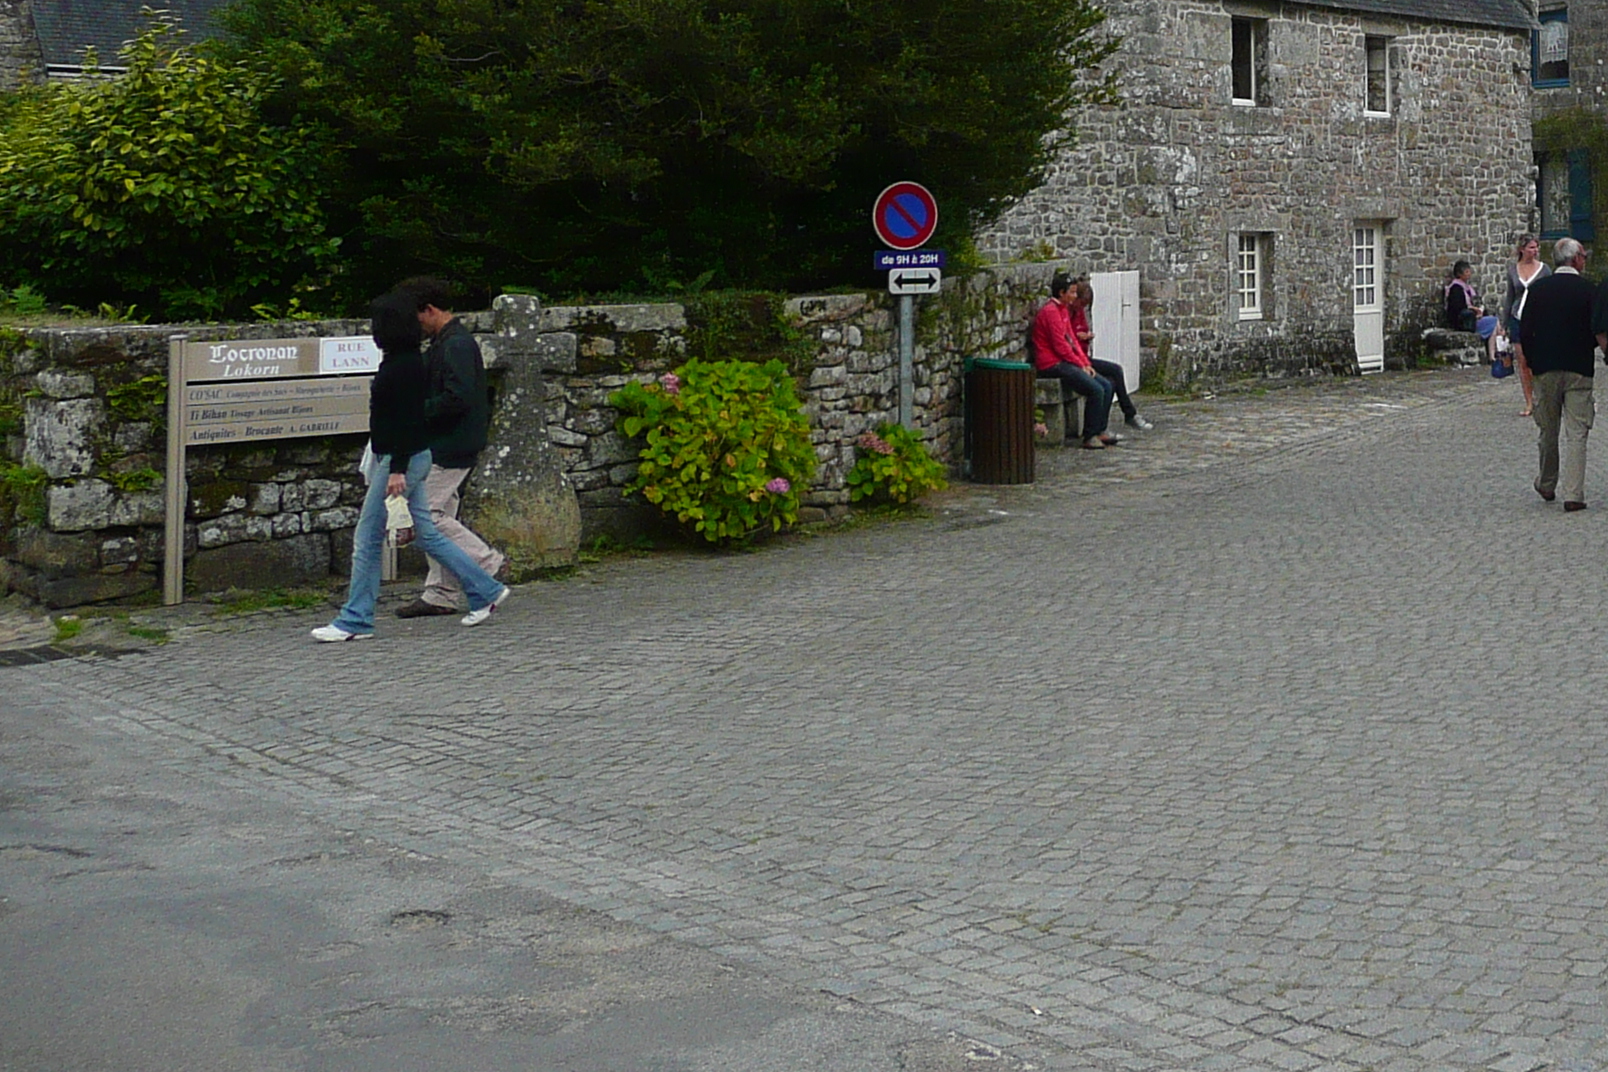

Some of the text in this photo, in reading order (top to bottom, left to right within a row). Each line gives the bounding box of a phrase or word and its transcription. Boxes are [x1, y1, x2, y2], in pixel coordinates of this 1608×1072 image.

[881, 253, 939, 265] de 9H à 20H
[336, 342, 366, 353] RUE
[209, 344, 299, 364] Locronan
[332, 356, 370, 368] LANN
[223, 363, 280, 378] Lokorn
